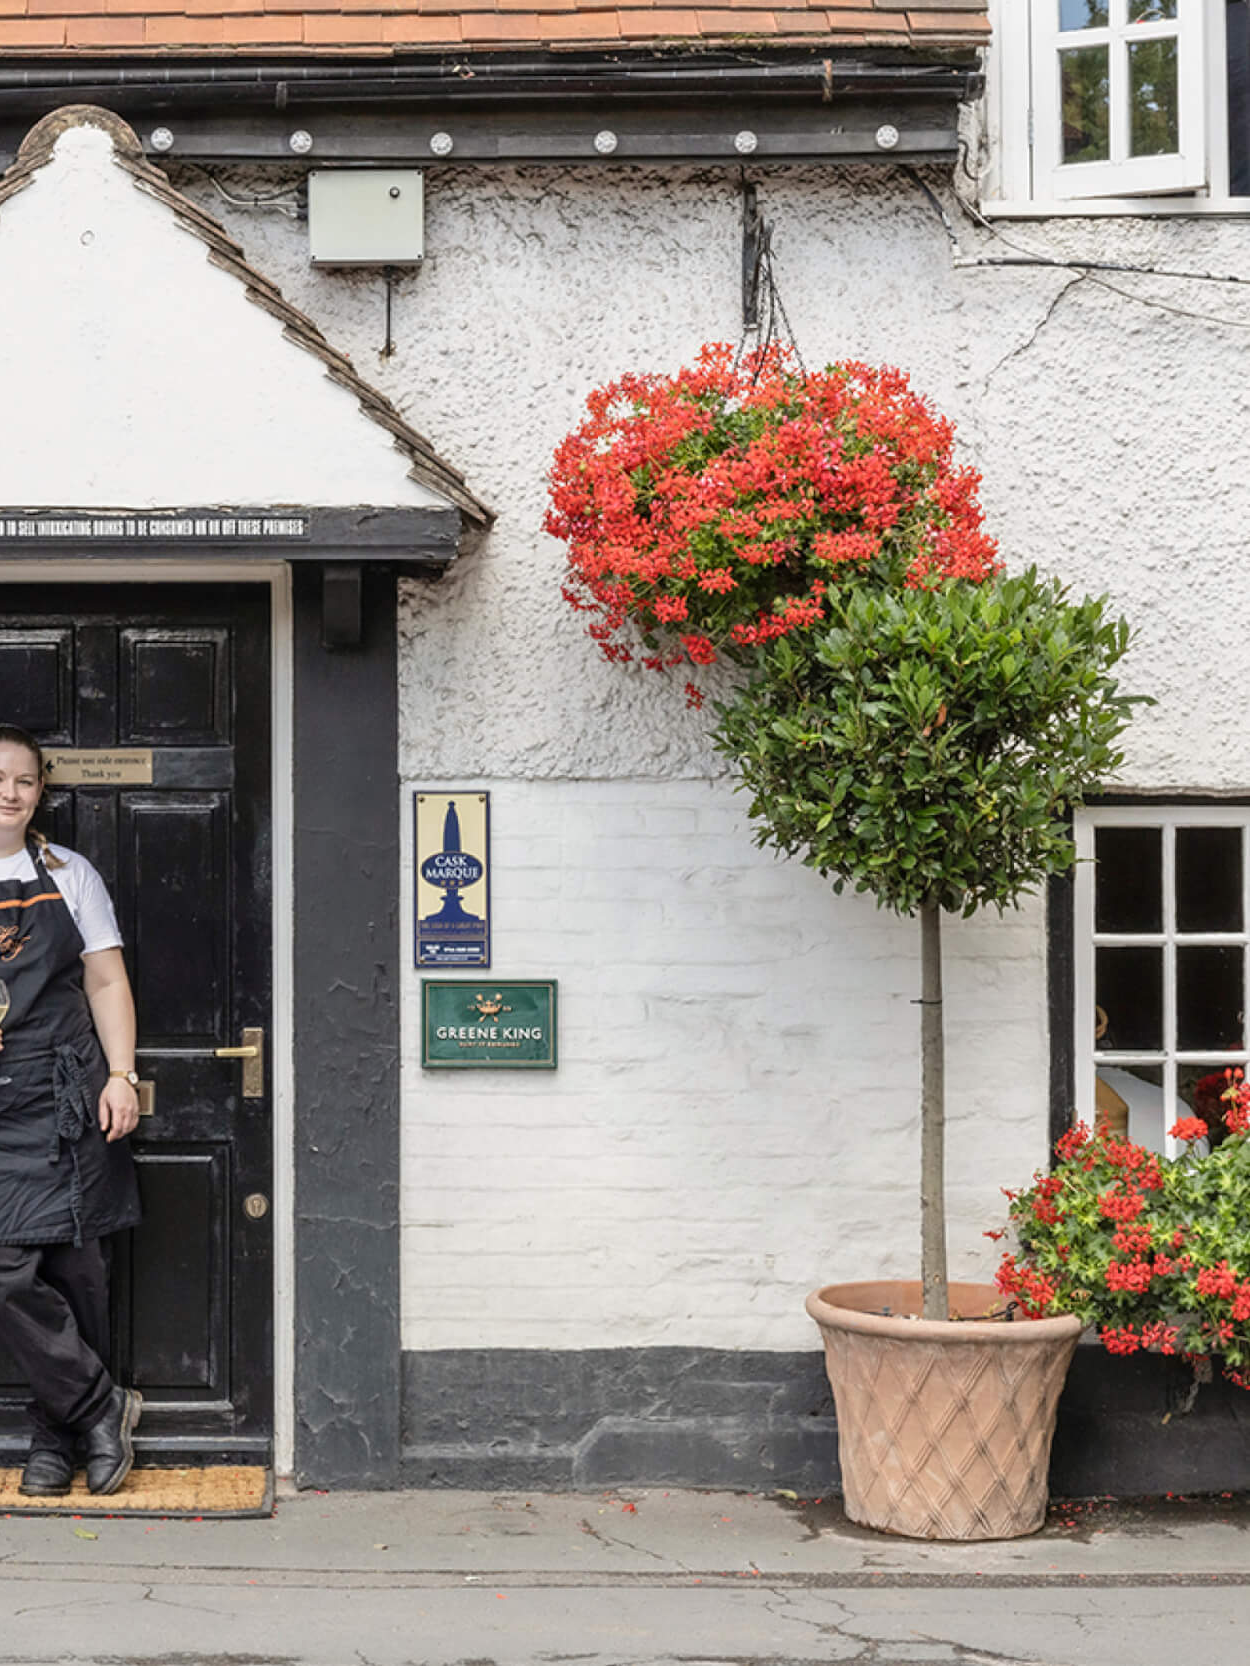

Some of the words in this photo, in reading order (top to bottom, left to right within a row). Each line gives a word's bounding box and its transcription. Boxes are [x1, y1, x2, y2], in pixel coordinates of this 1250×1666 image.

[6, 520, 16, 536] TO
[18, 520, 35, 536] SELL
[36, 520, 91, 536] INTOXICATING
[126, 520, 136, 536] TO
[138, 520, 148, 536] BE
[150, 520, 193, 535] CONSUMED
[237, 519, 262, 535] THESE
[263, 519, 304, 535] PREMISES
[81, 769, 104, 777] Thank
[106, 771, 121, 780] you
[435, 855, 468, 867] CASK
[425, 867, 478, 880] MARQUE
[436, 1026, 498, 1040] GREENE
[502, 1026, 542, 1040] KING
